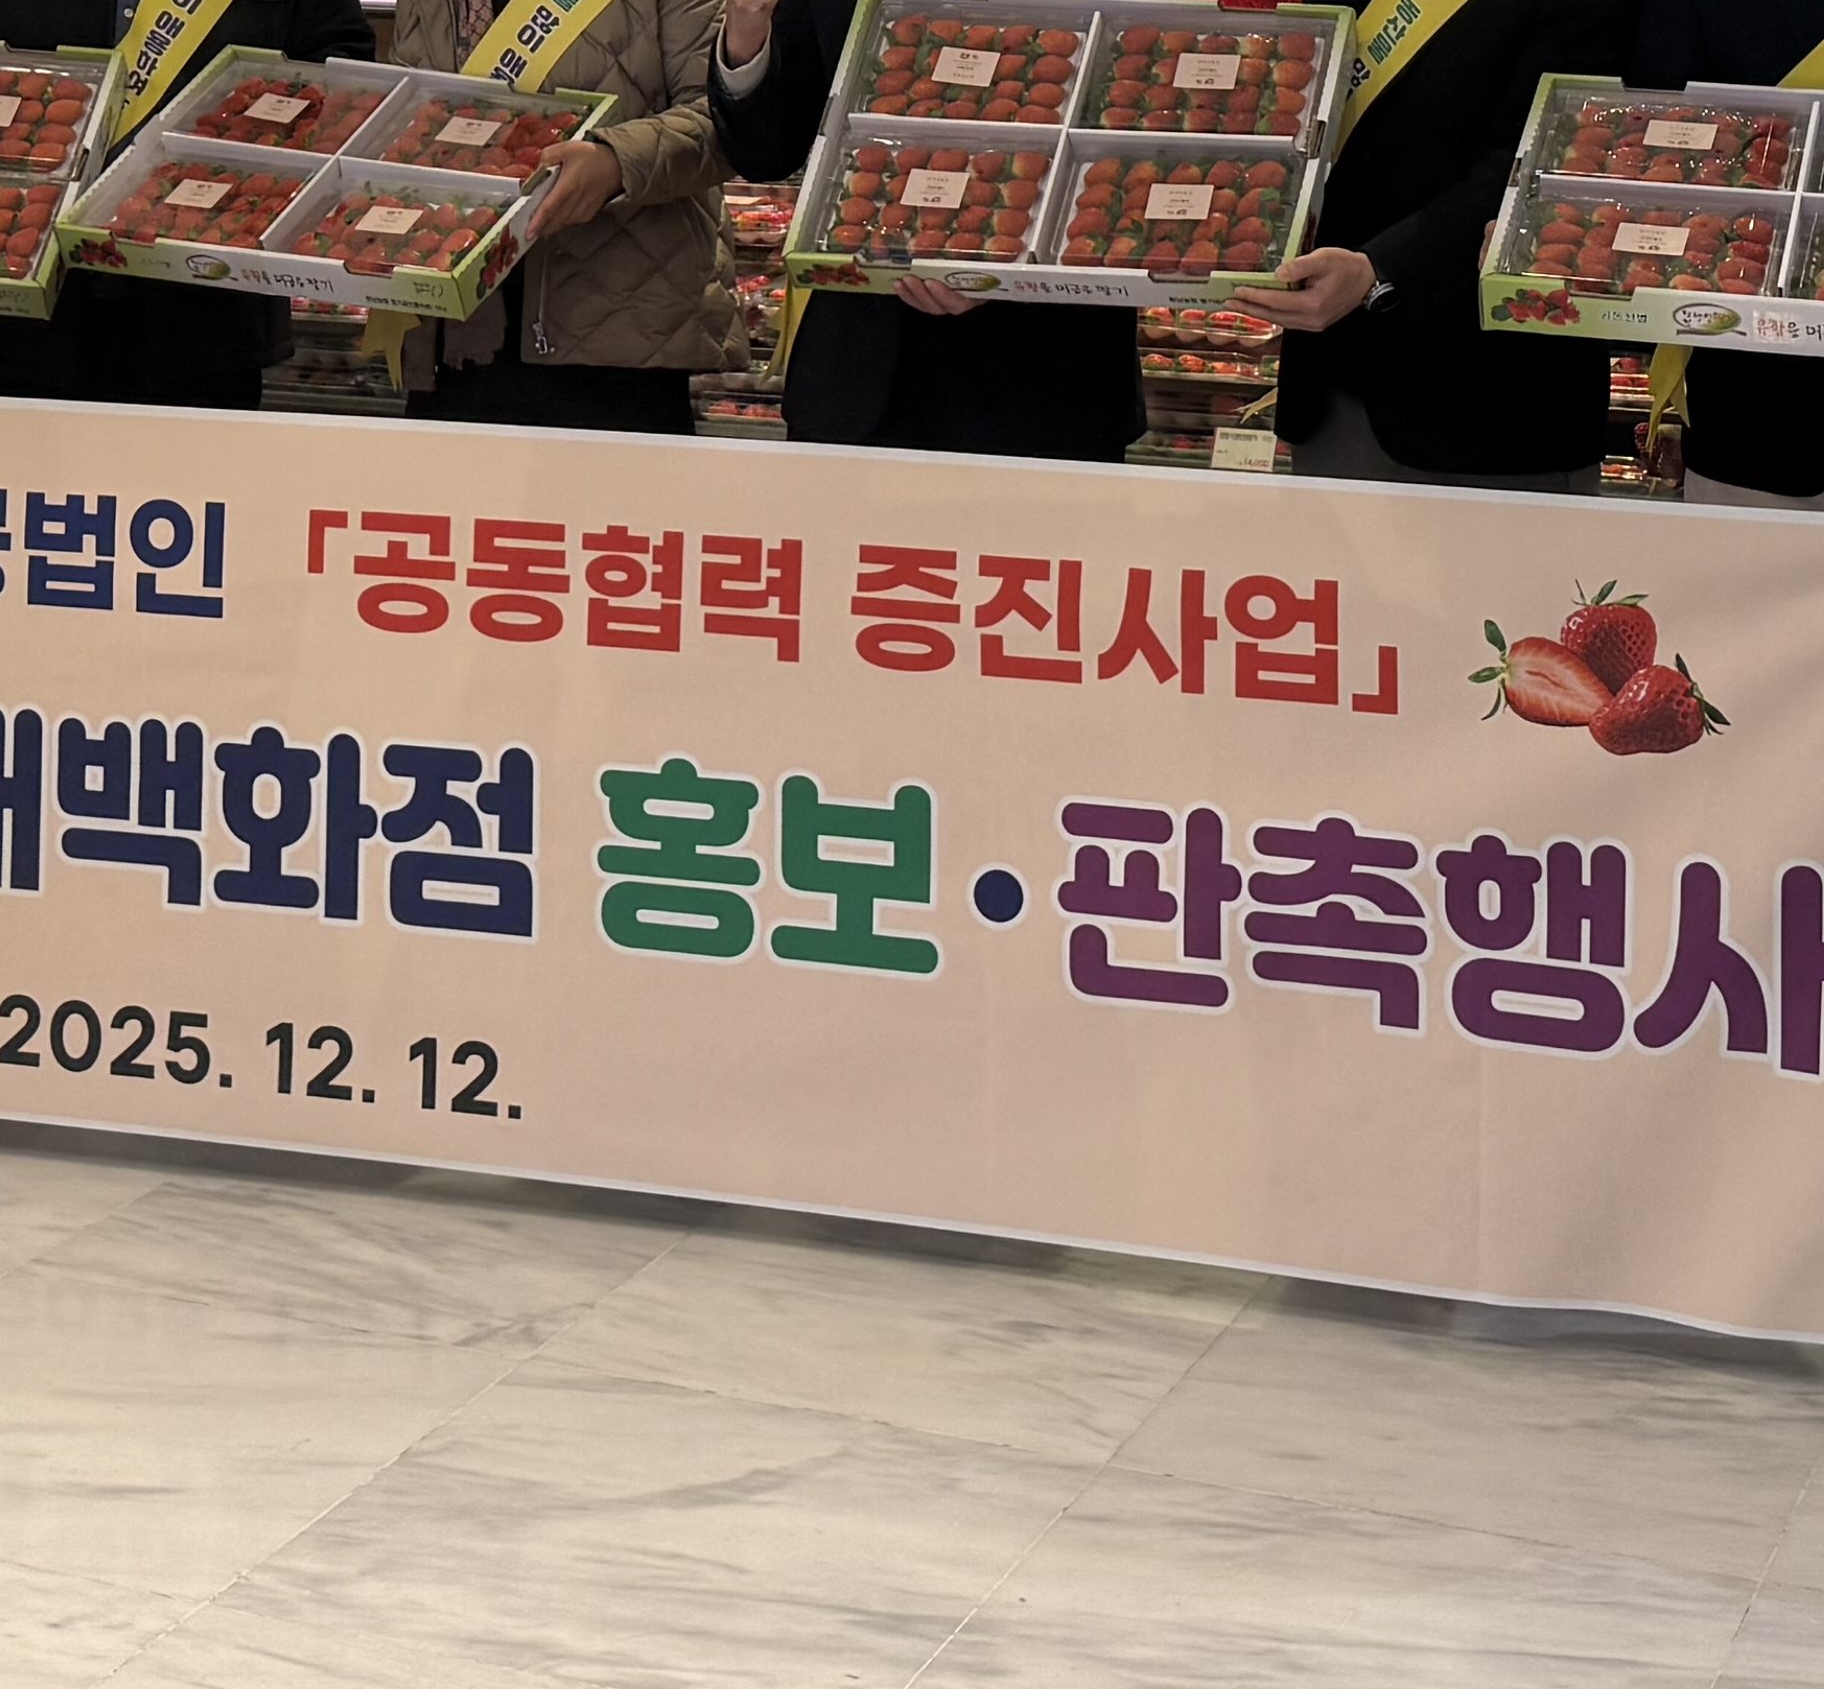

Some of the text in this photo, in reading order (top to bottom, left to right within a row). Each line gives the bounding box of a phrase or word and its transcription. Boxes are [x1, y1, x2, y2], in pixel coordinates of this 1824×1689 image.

[516, 4, 561, 54] 많이
[265, 1021, 377, 1104] 12.
[408, 1036, 523, 1121] 12.
